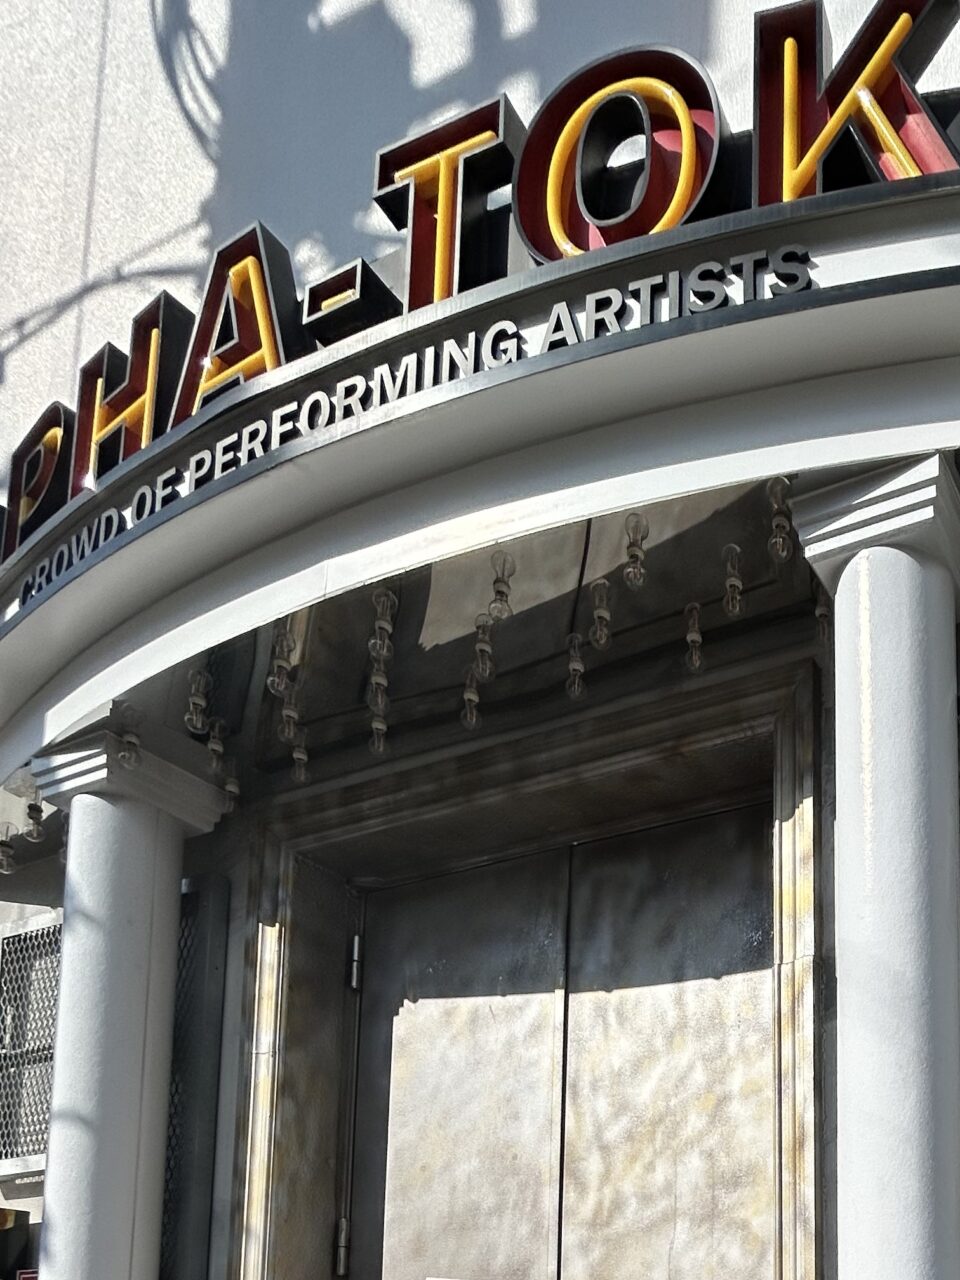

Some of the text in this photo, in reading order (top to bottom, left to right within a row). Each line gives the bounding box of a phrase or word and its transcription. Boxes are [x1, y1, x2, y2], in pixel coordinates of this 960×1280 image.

[19, 243, 812, 608] CROWD OF PERFORMING ARTISTS
